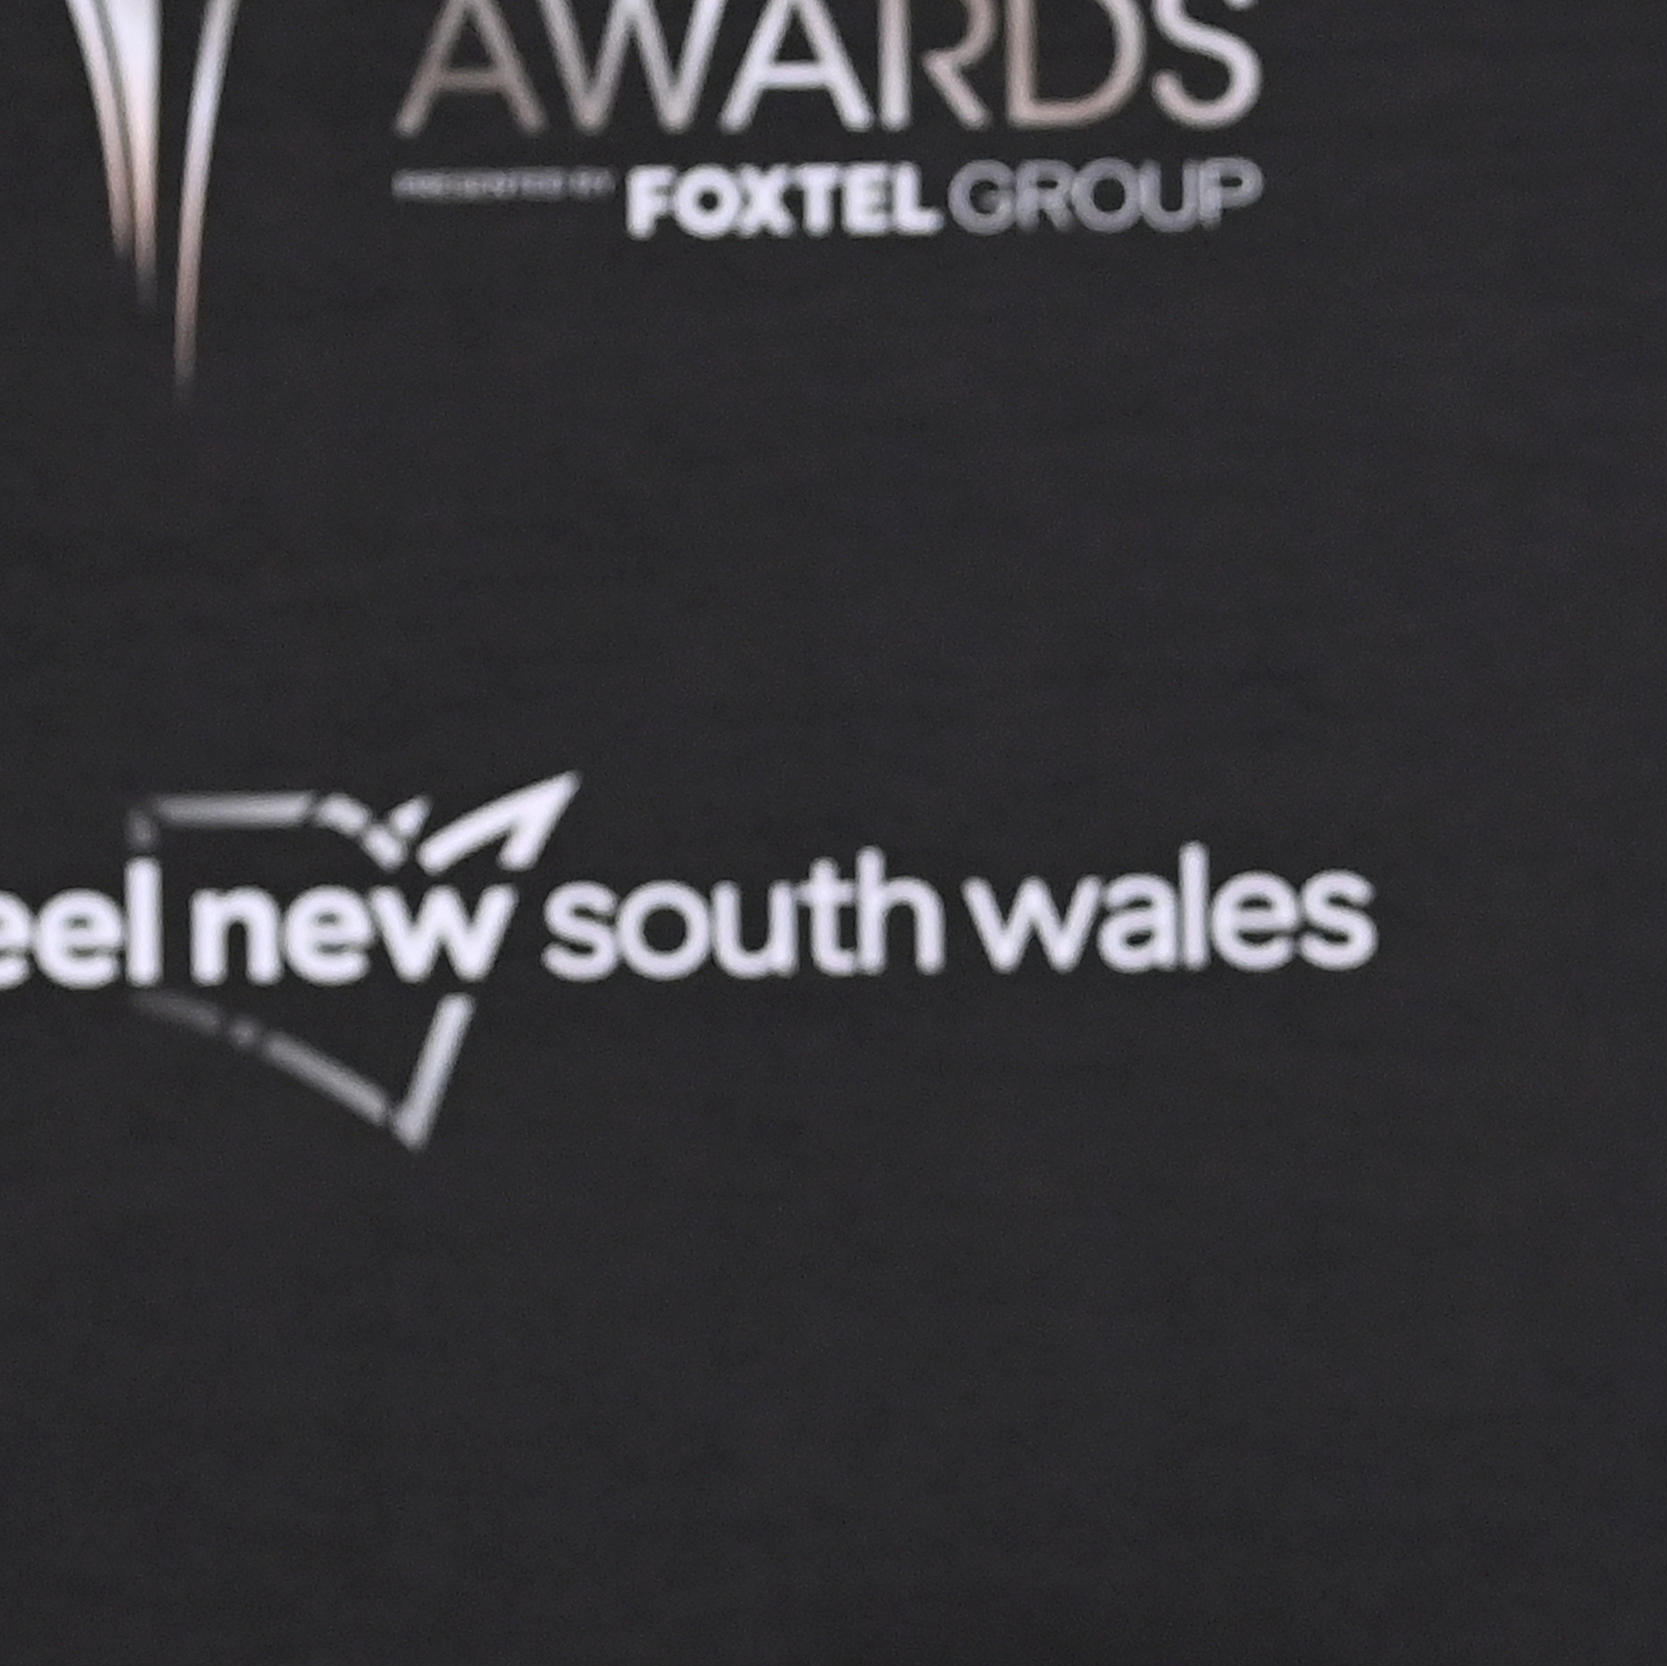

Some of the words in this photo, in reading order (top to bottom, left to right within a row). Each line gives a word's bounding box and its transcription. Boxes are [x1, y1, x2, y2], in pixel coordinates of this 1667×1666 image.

[396, 0, 1262, 134] AWARDS
[626, 160, 945, 239] FOXTEL
[949, 158, 1264, 234] GROUP
[190, 885, 518, 985] new
[544, 847, 945, 980] south
[964, 842, 1377, 972] wales
